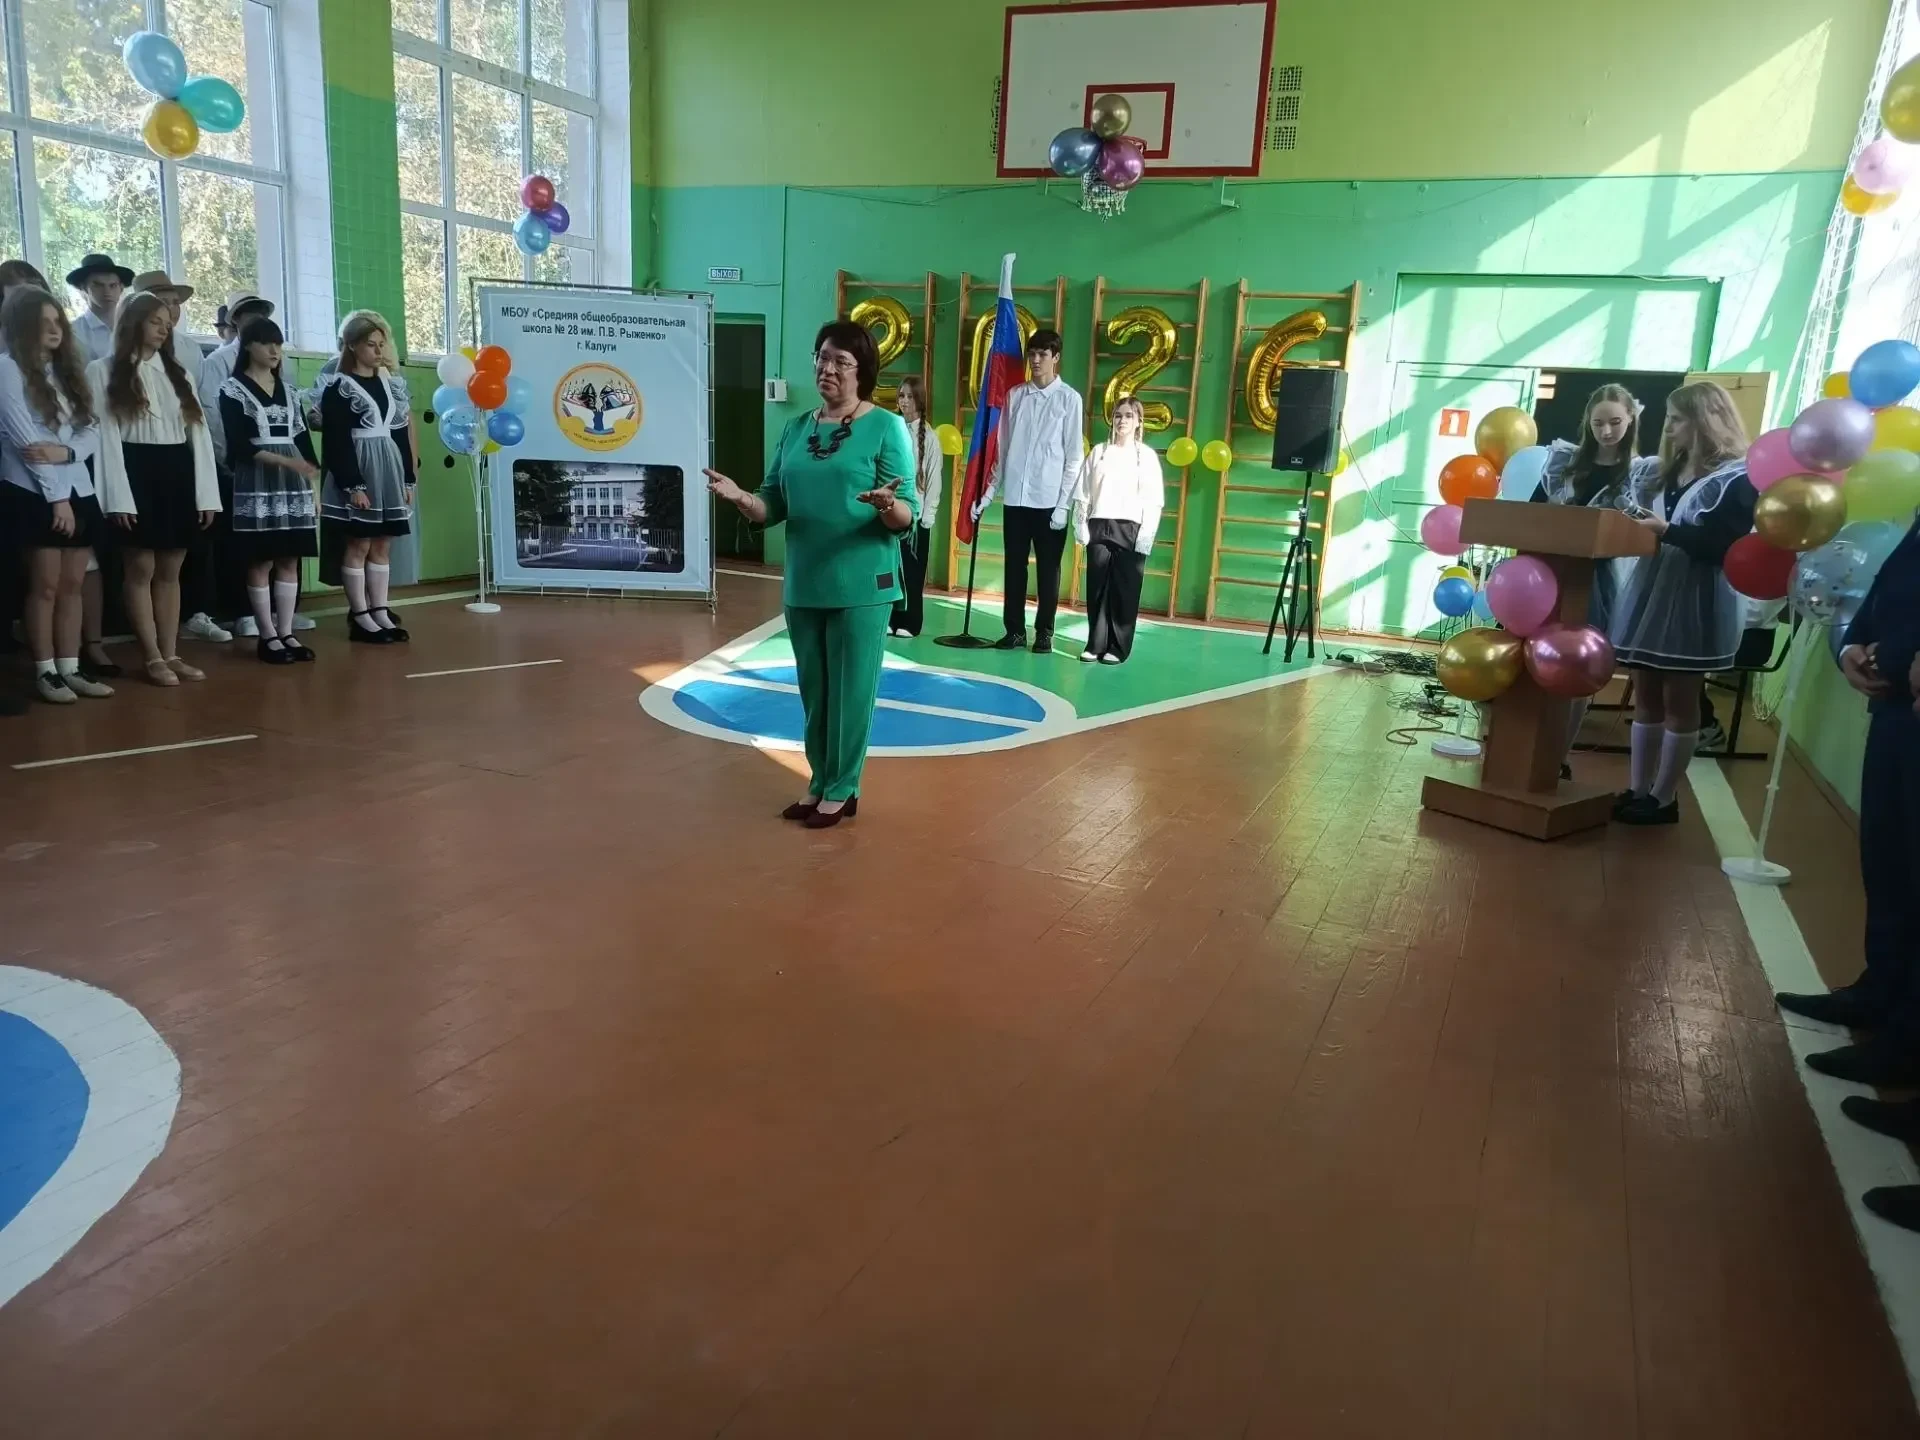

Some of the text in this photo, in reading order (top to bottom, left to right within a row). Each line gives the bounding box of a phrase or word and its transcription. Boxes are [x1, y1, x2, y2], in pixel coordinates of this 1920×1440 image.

[501, 306, 686, 328] МБОУ «Средняя общеобразовательная
[522, 324, 666, 341] школа № 28 им. П.В. Рыженко»
[577, 340, 617, 353] г. Калуги
